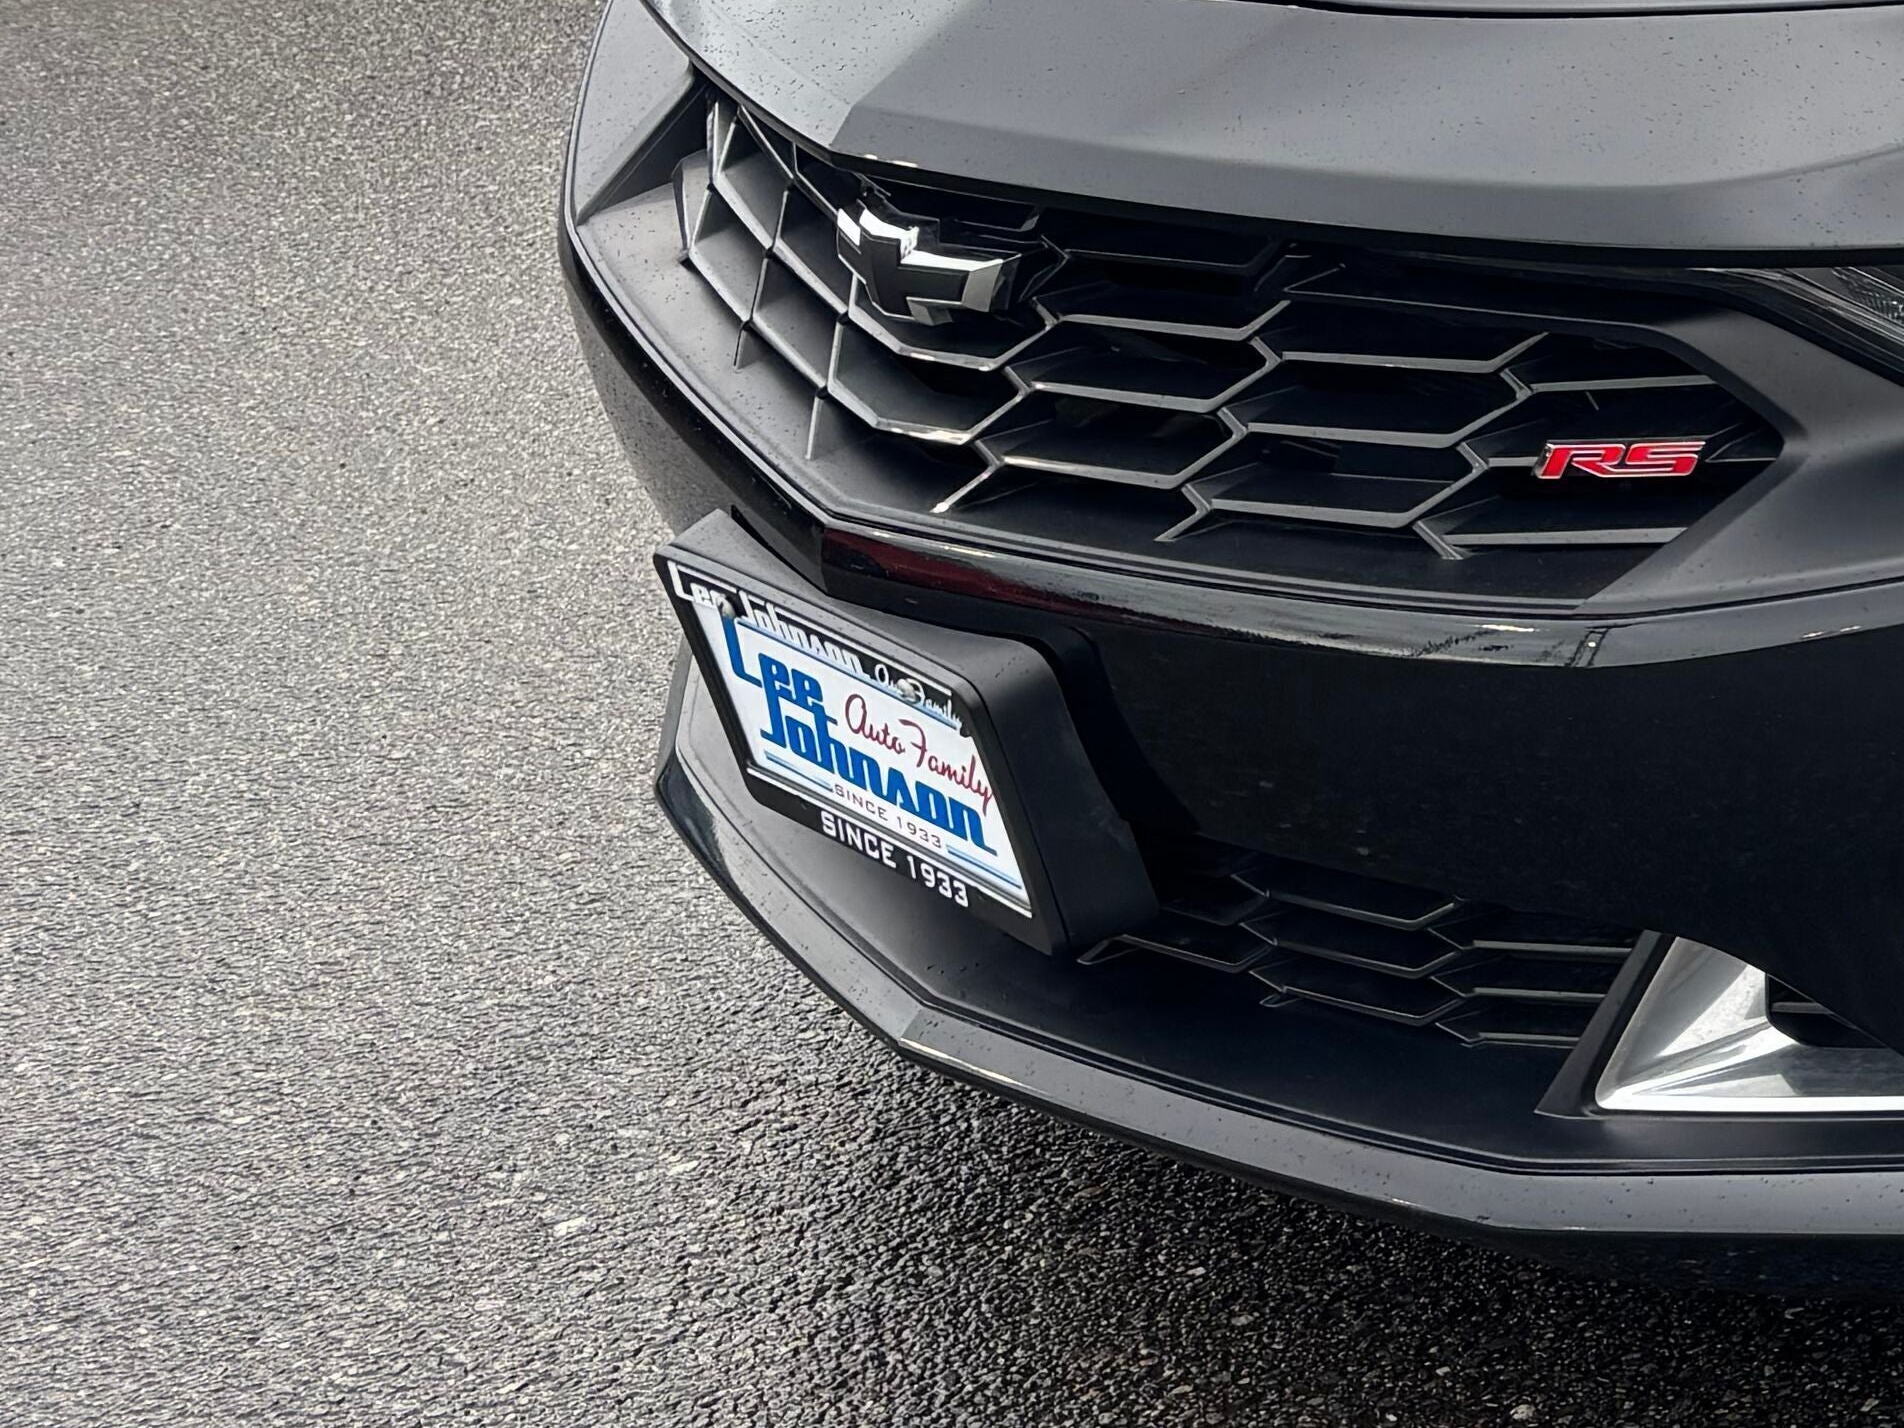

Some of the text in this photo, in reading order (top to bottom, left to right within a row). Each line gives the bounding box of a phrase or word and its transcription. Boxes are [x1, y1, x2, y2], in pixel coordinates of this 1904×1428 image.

[1536, 441, 1706, 479] RS
[736, 589, 876, 680] Johnson
[721, 615, 996, 817] Lee Auto Family
[761, 690, 998, 857] Johnson
[833, 783, 942, 849] SINCE 1933
[820, 810, 969, 907] SINCE 1933
